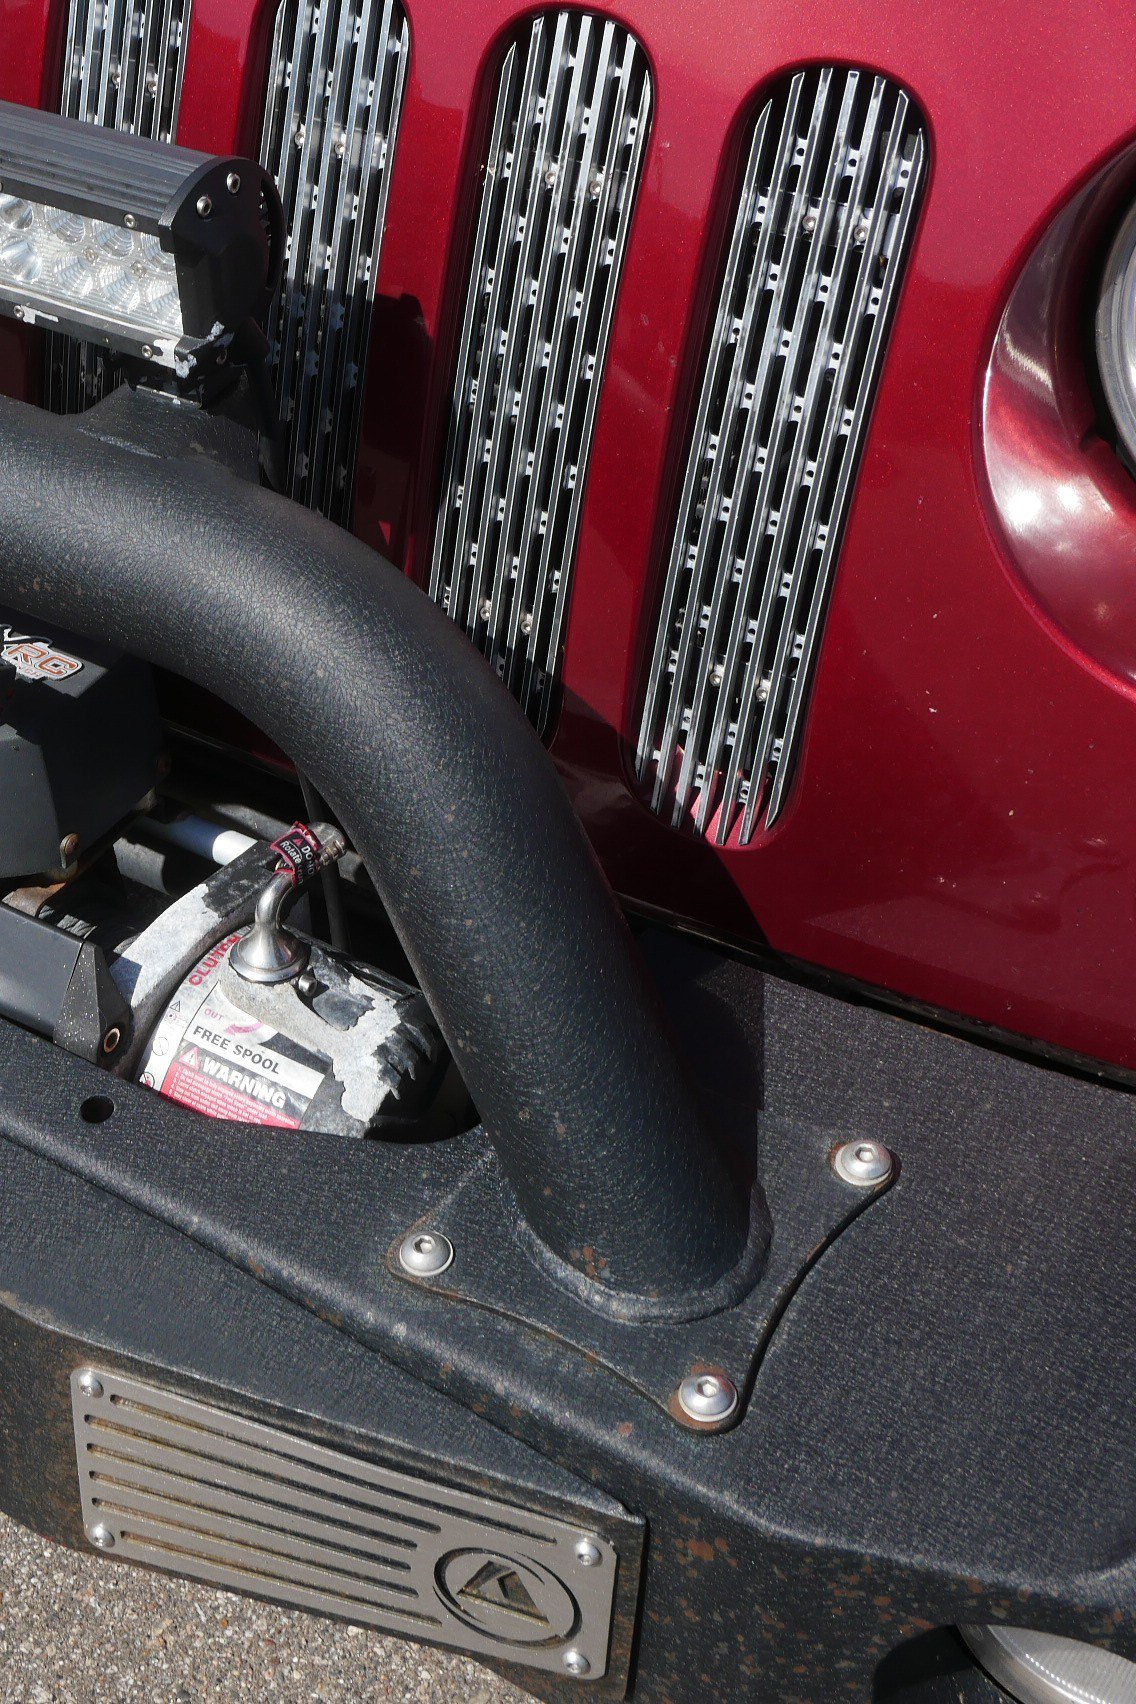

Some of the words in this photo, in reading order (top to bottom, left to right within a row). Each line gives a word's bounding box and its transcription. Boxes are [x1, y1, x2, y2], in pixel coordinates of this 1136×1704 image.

[280, 840, 302, 864] Rotate
[204, 1008, 224, 1021] OUT
[193, 1025, 231, 1052] FREE
[233, 1044, 280, 1075] SPOOL
[202, 1055, 287, 1109] WARNING
